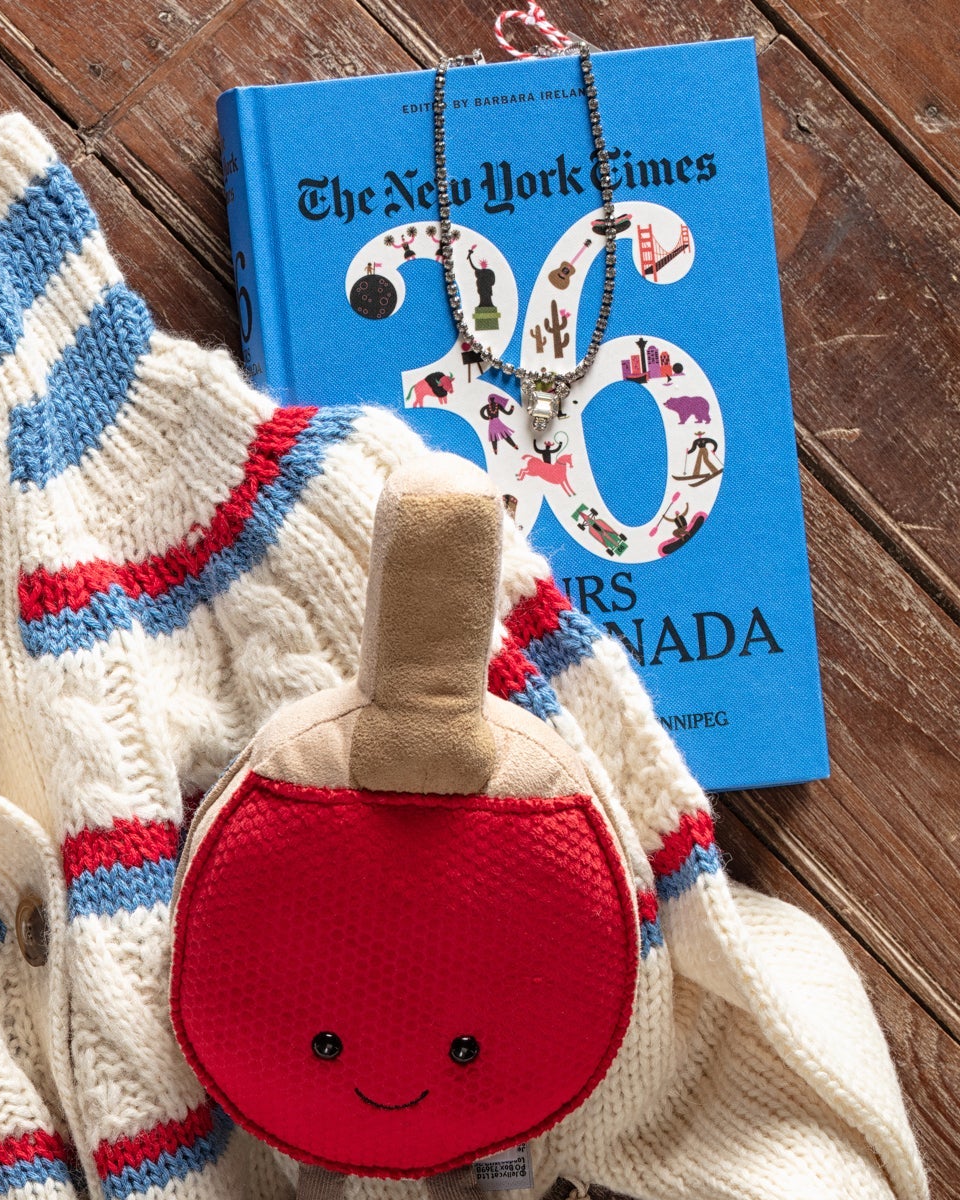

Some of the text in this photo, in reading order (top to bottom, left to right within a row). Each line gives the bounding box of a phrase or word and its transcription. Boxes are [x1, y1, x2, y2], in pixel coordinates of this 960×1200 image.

[402, 86, 590, 114] EDIT BY BARBARA IRELAN
[297, 147, 718, 225] The New York Times
[476, 1172, 490, 1180] Ltd
[500, 1164, 514, 1172] Box
